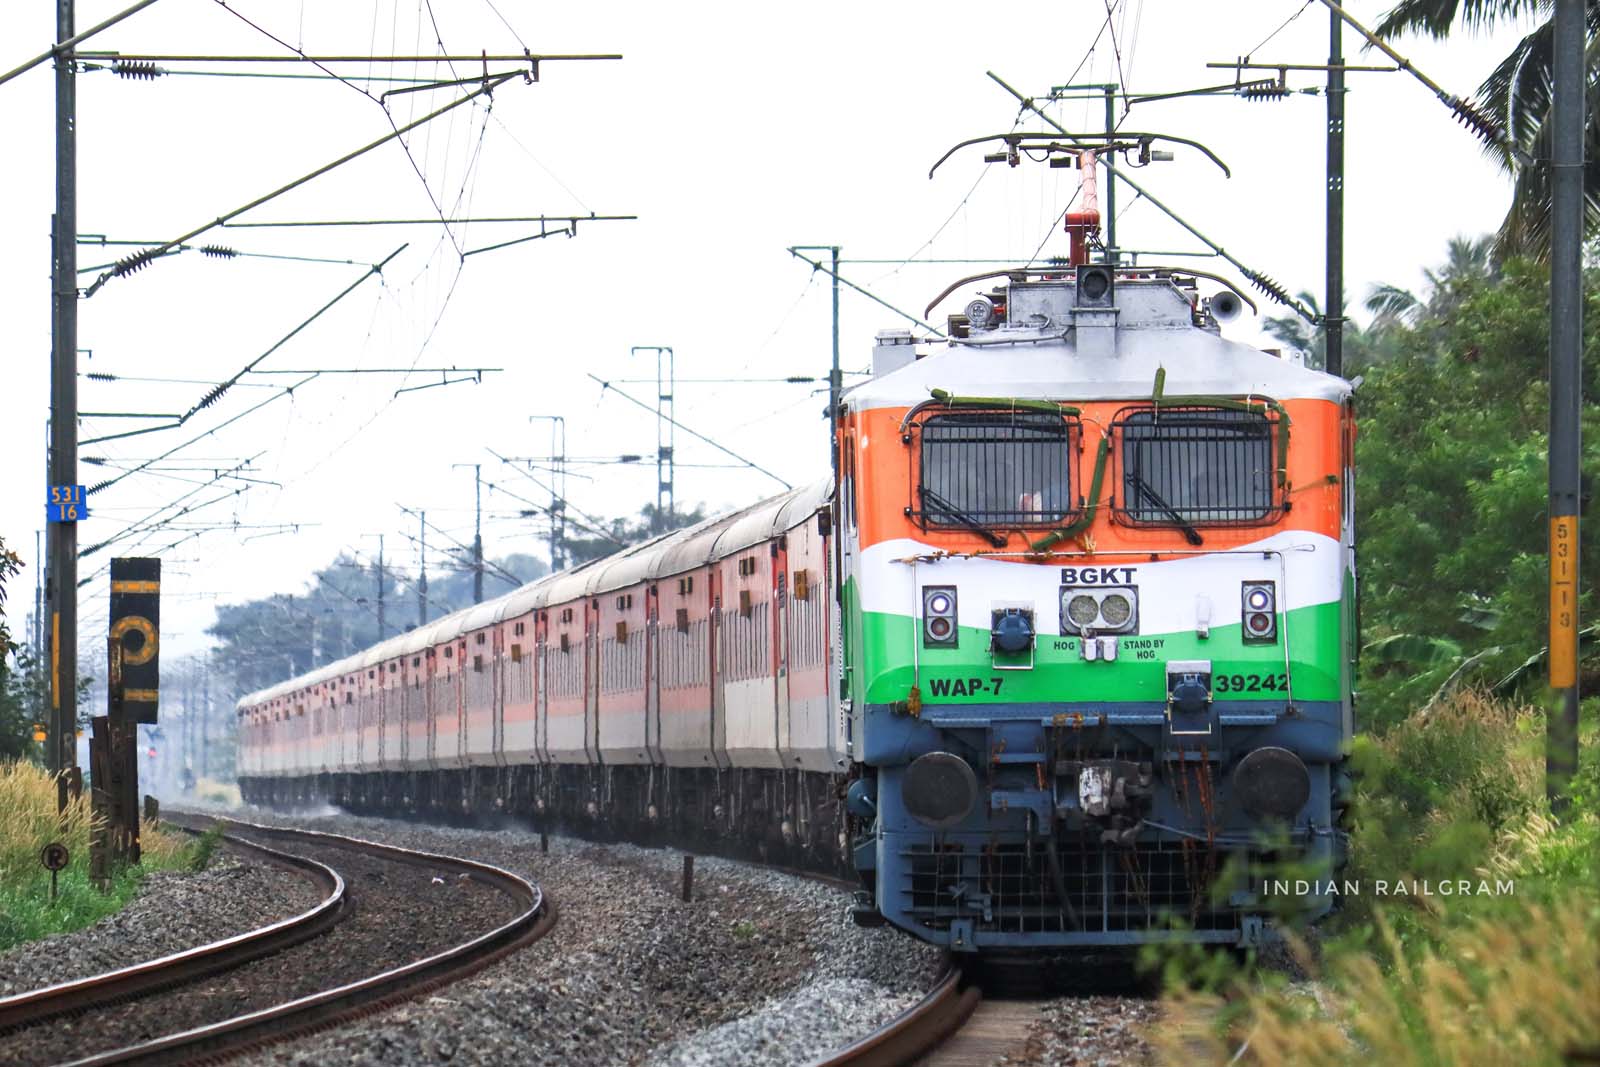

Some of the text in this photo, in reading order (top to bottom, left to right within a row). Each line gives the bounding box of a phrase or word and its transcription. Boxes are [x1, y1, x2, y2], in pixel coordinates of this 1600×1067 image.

[51, 486, 79, 503] 531
[60, 503, 77, 521] 16
[1557, 524, 1568, 576] 531
[1061, 567, 1137, 584] BGKT
[1053, 641, 1075, 651] HOG
[1123, 639, 1165, 650] STAND BY
[1136, 650, 1155, 660] HOG
[929, 677, 1003, 697] WAP-7
[1215, 673, 1292, 693] 39242
